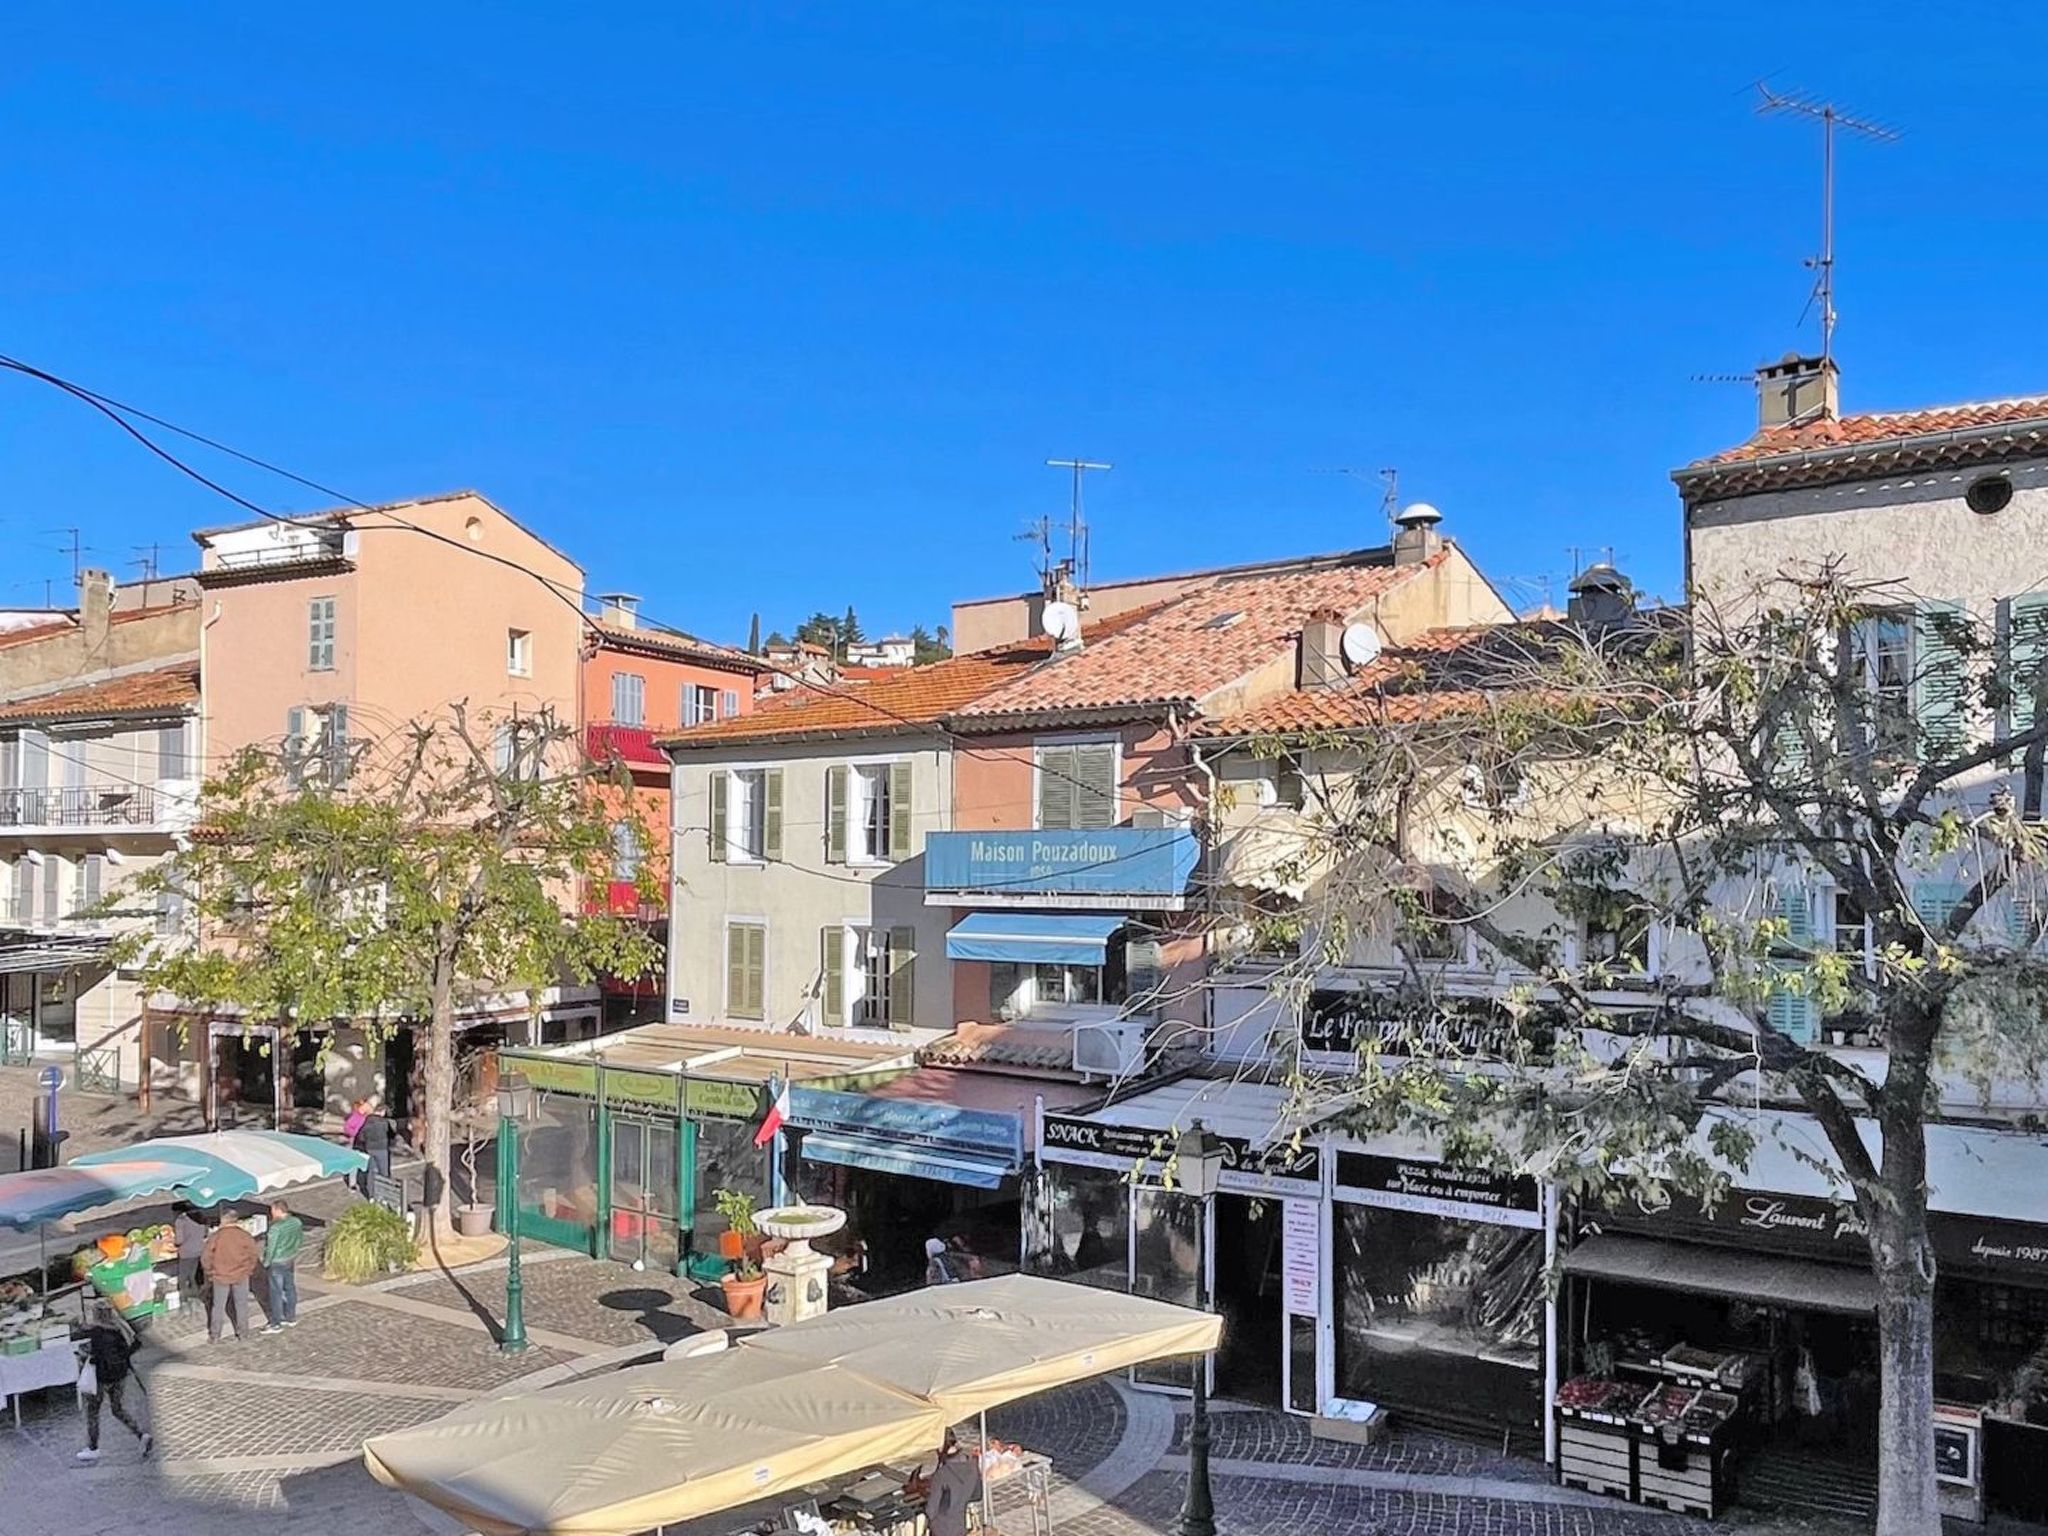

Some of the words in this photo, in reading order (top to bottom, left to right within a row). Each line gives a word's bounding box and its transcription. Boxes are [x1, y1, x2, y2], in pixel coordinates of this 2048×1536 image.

[971, 840, 1024, 862] Maison
[1032, 840, 1118, 862] Pouzadoux
[1309, 1010, 1335, 1039] Le
[1046, 1122, 1100, 1148] SNACK
[1430, 1185, 1443, 1195] ou
[1454, 1187, 1502, 1202] emporter
[1740, 1197, 1827, 1229] Laurent
[2015, 1246, 2048, 1263] 1987
